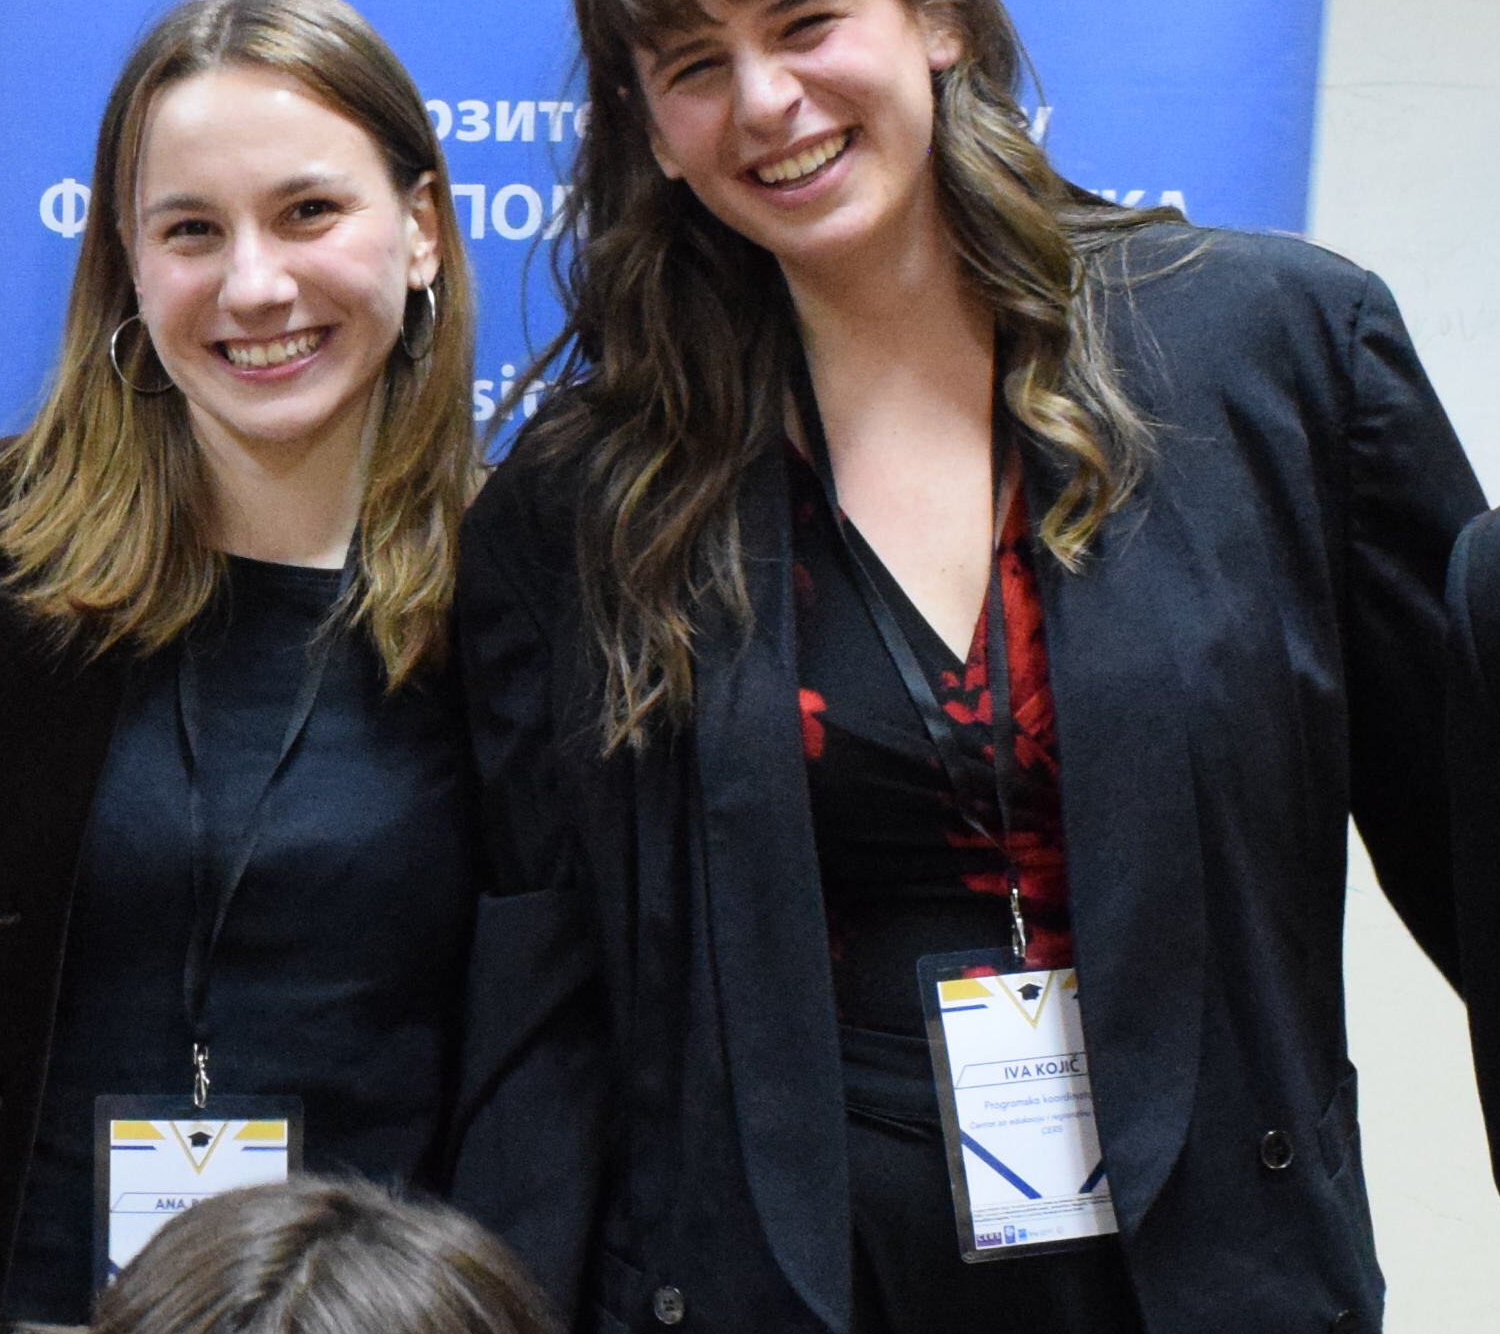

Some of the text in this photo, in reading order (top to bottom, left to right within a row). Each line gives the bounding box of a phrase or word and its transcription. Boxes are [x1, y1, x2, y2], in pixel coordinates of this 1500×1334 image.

[1004, 1055, 1081, 1080] IVA KOJIĆ
[155, 1198, 185, 1209] ANA
